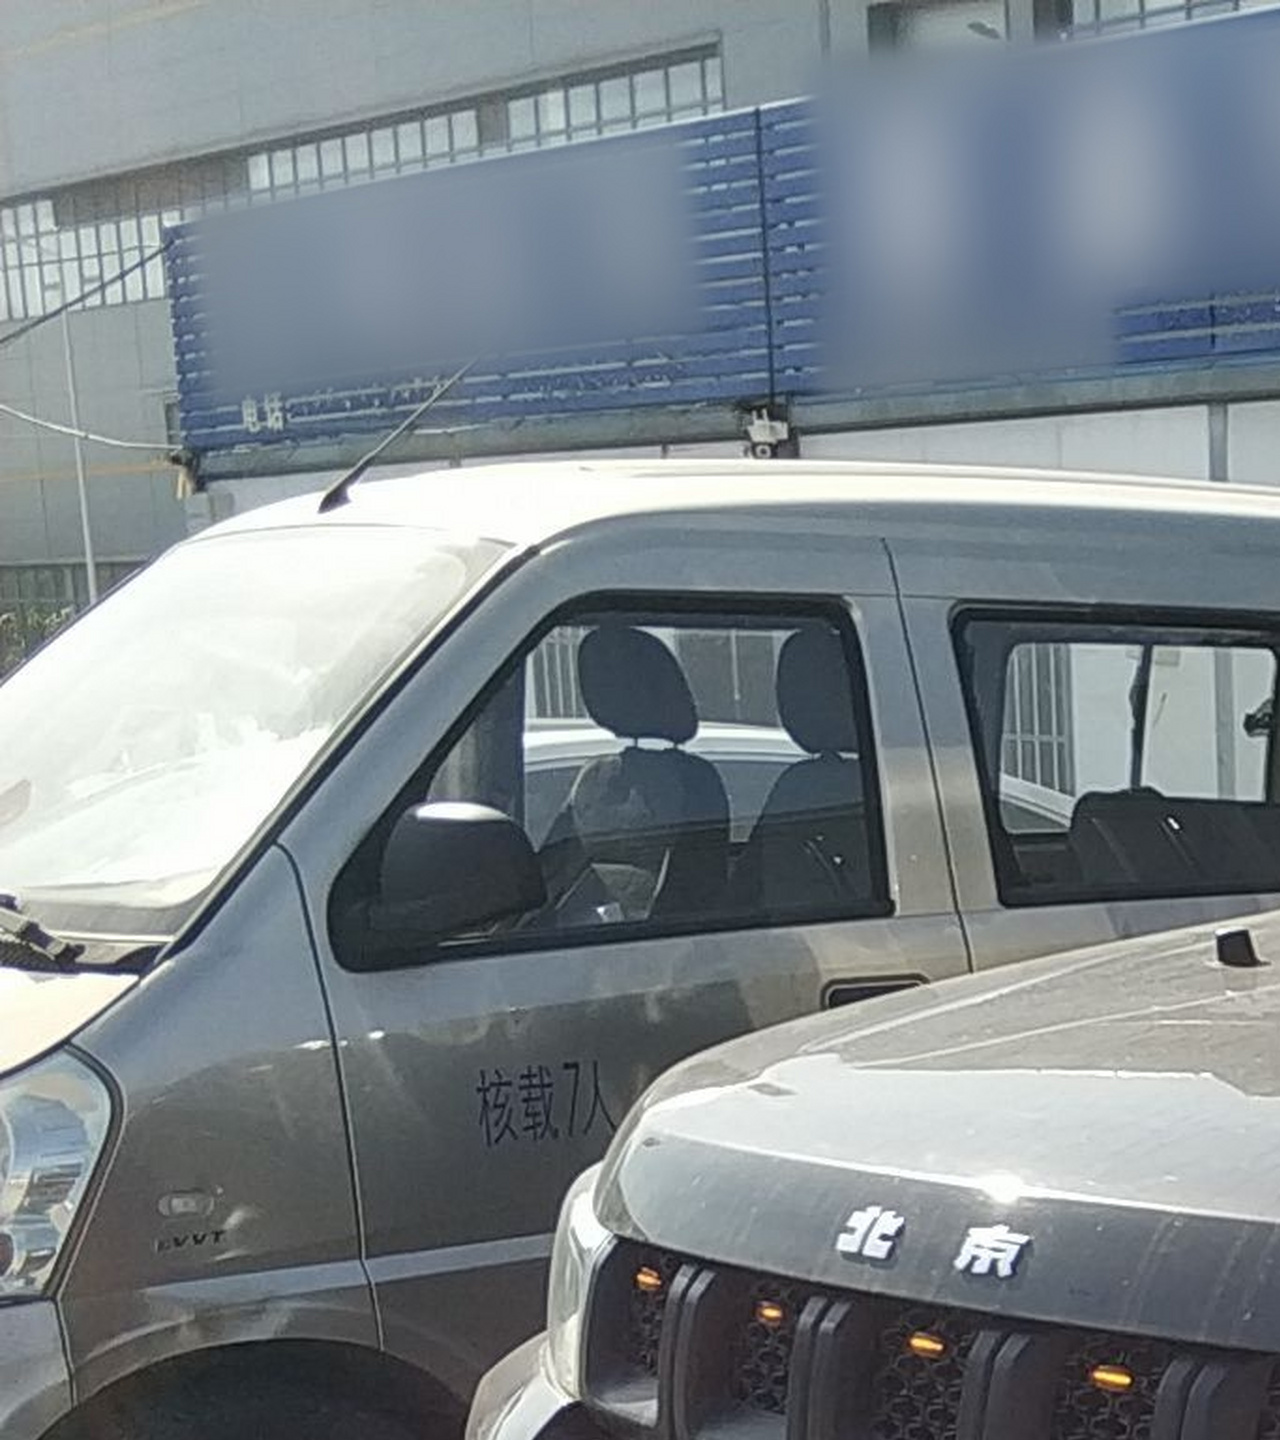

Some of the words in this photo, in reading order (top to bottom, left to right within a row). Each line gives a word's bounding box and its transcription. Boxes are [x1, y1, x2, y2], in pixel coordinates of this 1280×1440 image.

[476, 1060, 618, 1147] 核载7人
[836, 1206, 1032, 1278] 北京
